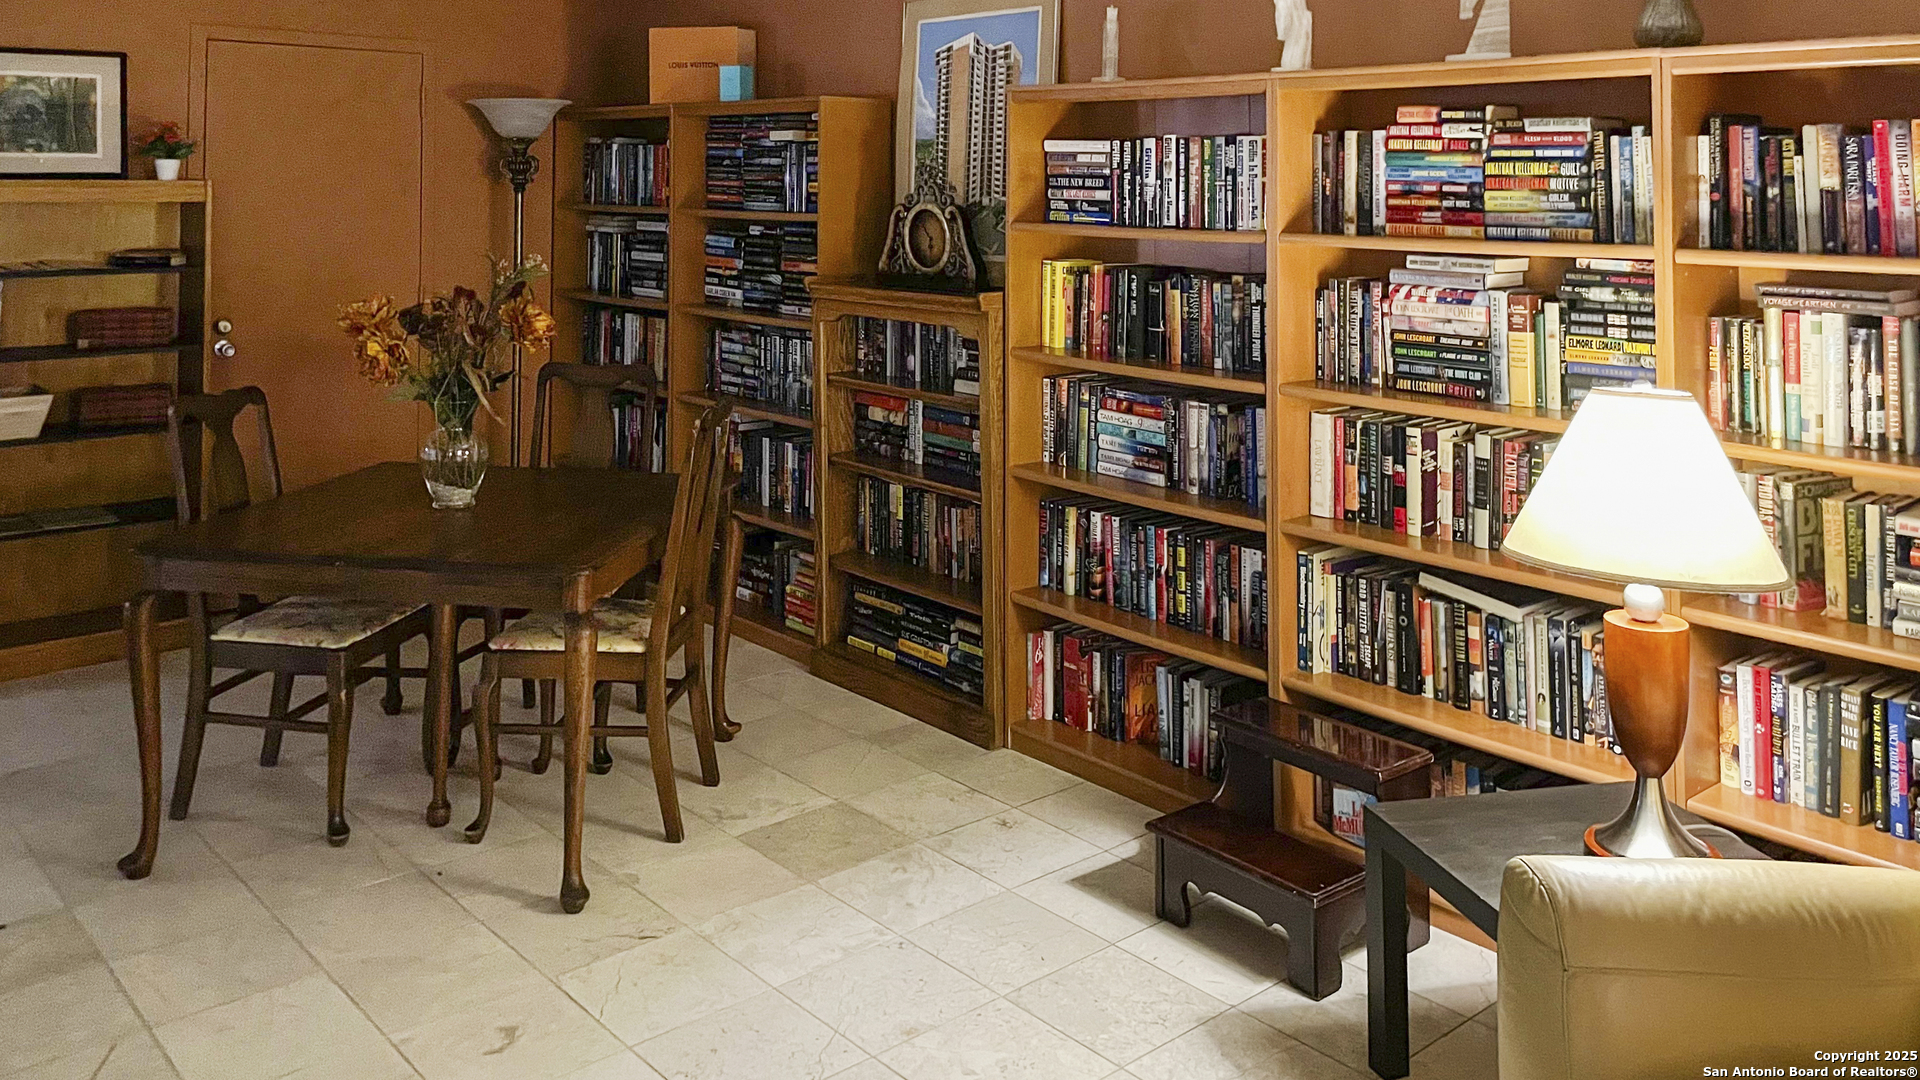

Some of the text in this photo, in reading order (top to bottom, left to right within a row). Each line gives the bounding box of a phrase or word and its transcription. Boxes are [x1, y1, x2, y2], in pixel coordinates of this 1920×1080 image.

[668, 61, 719, 69] LOUIS VUITTON
[1112, 140, 1121, 169] Griffin
[1388, 139, 1413, 150] JONATHAN
[1413, 139, 1443, 151] KELLERMAN
[1123, 141, 1131, 170] Griffin
[1485, 162, 1581, 176] JONATHAN KELLERMAN GUILT
[1846, 137, 1860, 201] SARA PARETSKY
[1896, 134, 1911, 207] DOING HARM
[1057, 177, 1104, 187] THE NEW BREED
[1549, 178, 1579, 190] MOTIVE
[1487, 227, 1550, 238] JONATHAN KELLERMAN
[1372, 287, 1381, 308] MAD
[1763, 297, 1836, 309] VOYAGE EARTHEN
[1372, 310, 1380, 331] DOG
[1395, 304, 1410, 313] JOHN
[1453, 307, 1474, 318] OATH
[1252, 305, 1261, 362] THUNDER POINT
[1350, 314, 1358, 345] KITCHEN
[1406, 334, 1436, 344] LESCROART
[1788, 322, 1796, 341] Tom
[1394, 346, 1407, 354] JOHN
[1407, 347, 1437, 358] LESCROART
[1568, 338, 1622, 352] ELMORE LEONARD
[1612, 354, 1640, 365] PAGAN
[1744, 355, 1752, 370] DOG
[1802, 342, 1812, 378] Picoult
[1397, 364, 1409, 372] JOHN
[1445, 368, 1454, 378] THE
[1468, 370, 1481, 381] CLUB
[1888, 339, 1898, 407] THE CURSE OF
[1395, 379, 1446, 395] JOHN LESCROART
[1100, 413, 1143, 429] TAMI HOAG 9
[1166, 409, 1175, 453] Retribution
[1100, 453, 1114, 461] TAMI
[1314, 439, 1322, 485] LAWRENCE
[1099, 465, 1111, 473] TAMI
[1504, 453, 1517, 492] LOWELL
[1759, 481, 1773, 521] THOMAS
[1848, 508, 1858, 580] CRESCENT CITY
[1886, 516, 1896, 582] THE FIRST PATIENT
[1299, 566, 1307, 610] Biochemistry
[1358, 579, 1368, 634] BRAD MELTZER
[1453, 602, 1466, 663] STEVE MARTINI
[1873, 693, 1882, 713] YOU
[1742, 716, 1751, 734] Story
[1840, 724, 1861, 738] ANNE
[1873, 713, 1881, 731] ARE
[1840, 736, 1861, 750] RICE
[1874, 733, 1882, 759] NEXT
[1792, 724, 1802, 782] BULLET TRAIN
[1889, 713, 1900, 798] NANCY TAYLOR ROSENBERG
